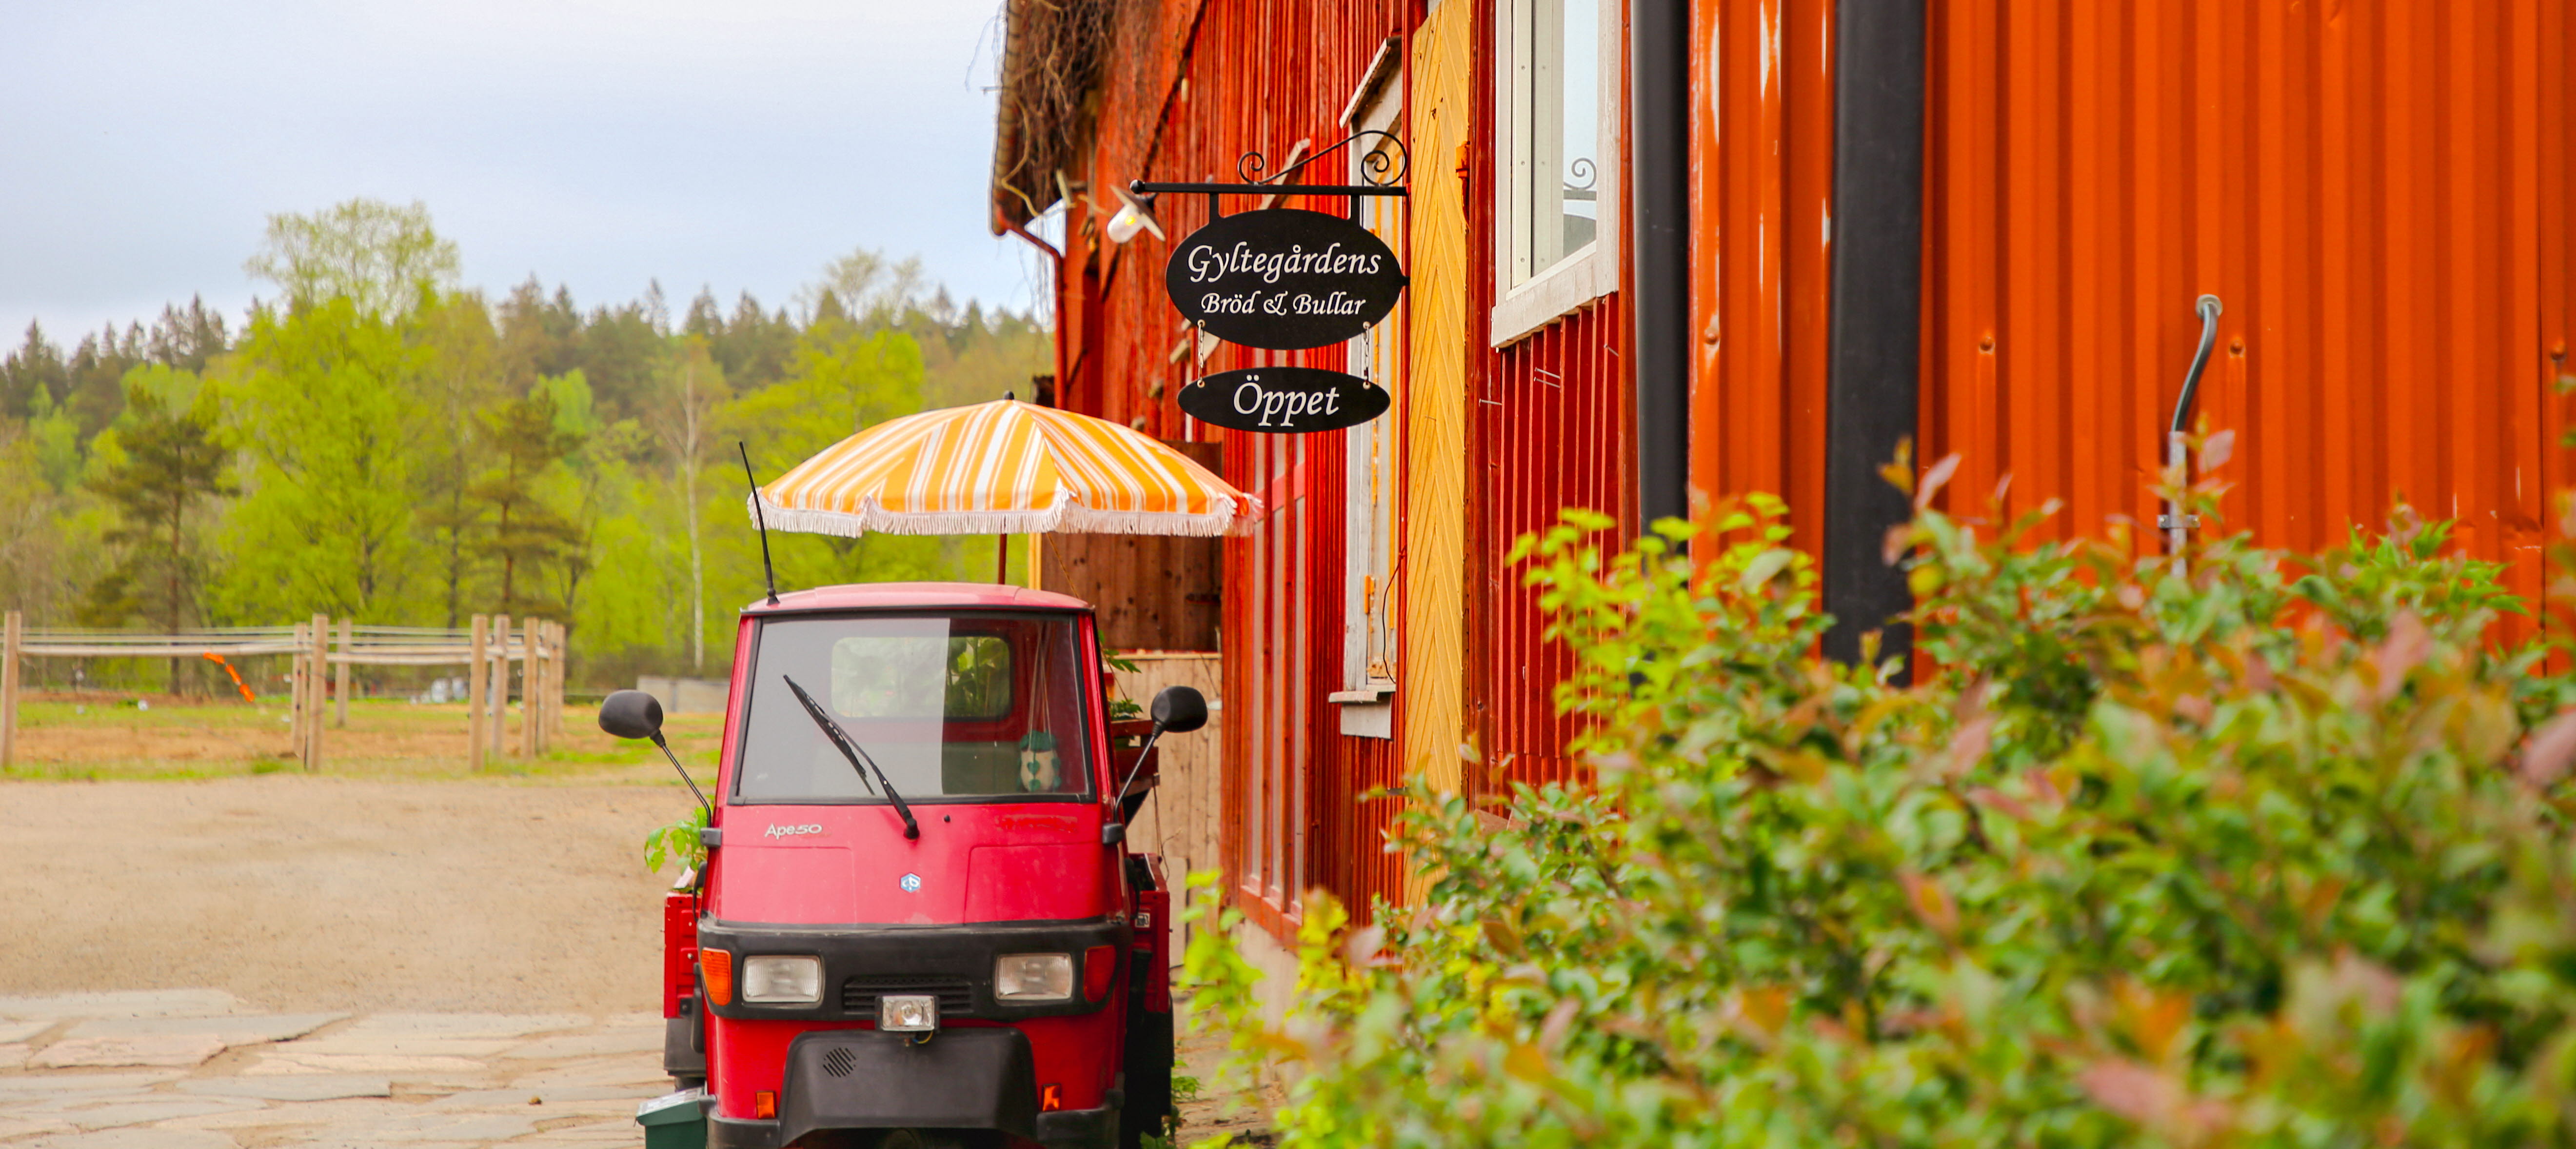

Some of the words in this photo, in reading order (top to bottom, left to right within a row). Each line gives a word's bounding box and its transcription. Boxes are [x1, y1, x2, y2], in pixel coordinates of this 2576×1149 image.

[1188, 241, 1382, 284] Gyltegårdens
[1200, 290, 1261, 314] Bröd
[1263, 291, 1288, 316] &
[1292, 291, 1366, 315] Bullar
[1233, 374, 1340, 427] Öppet
